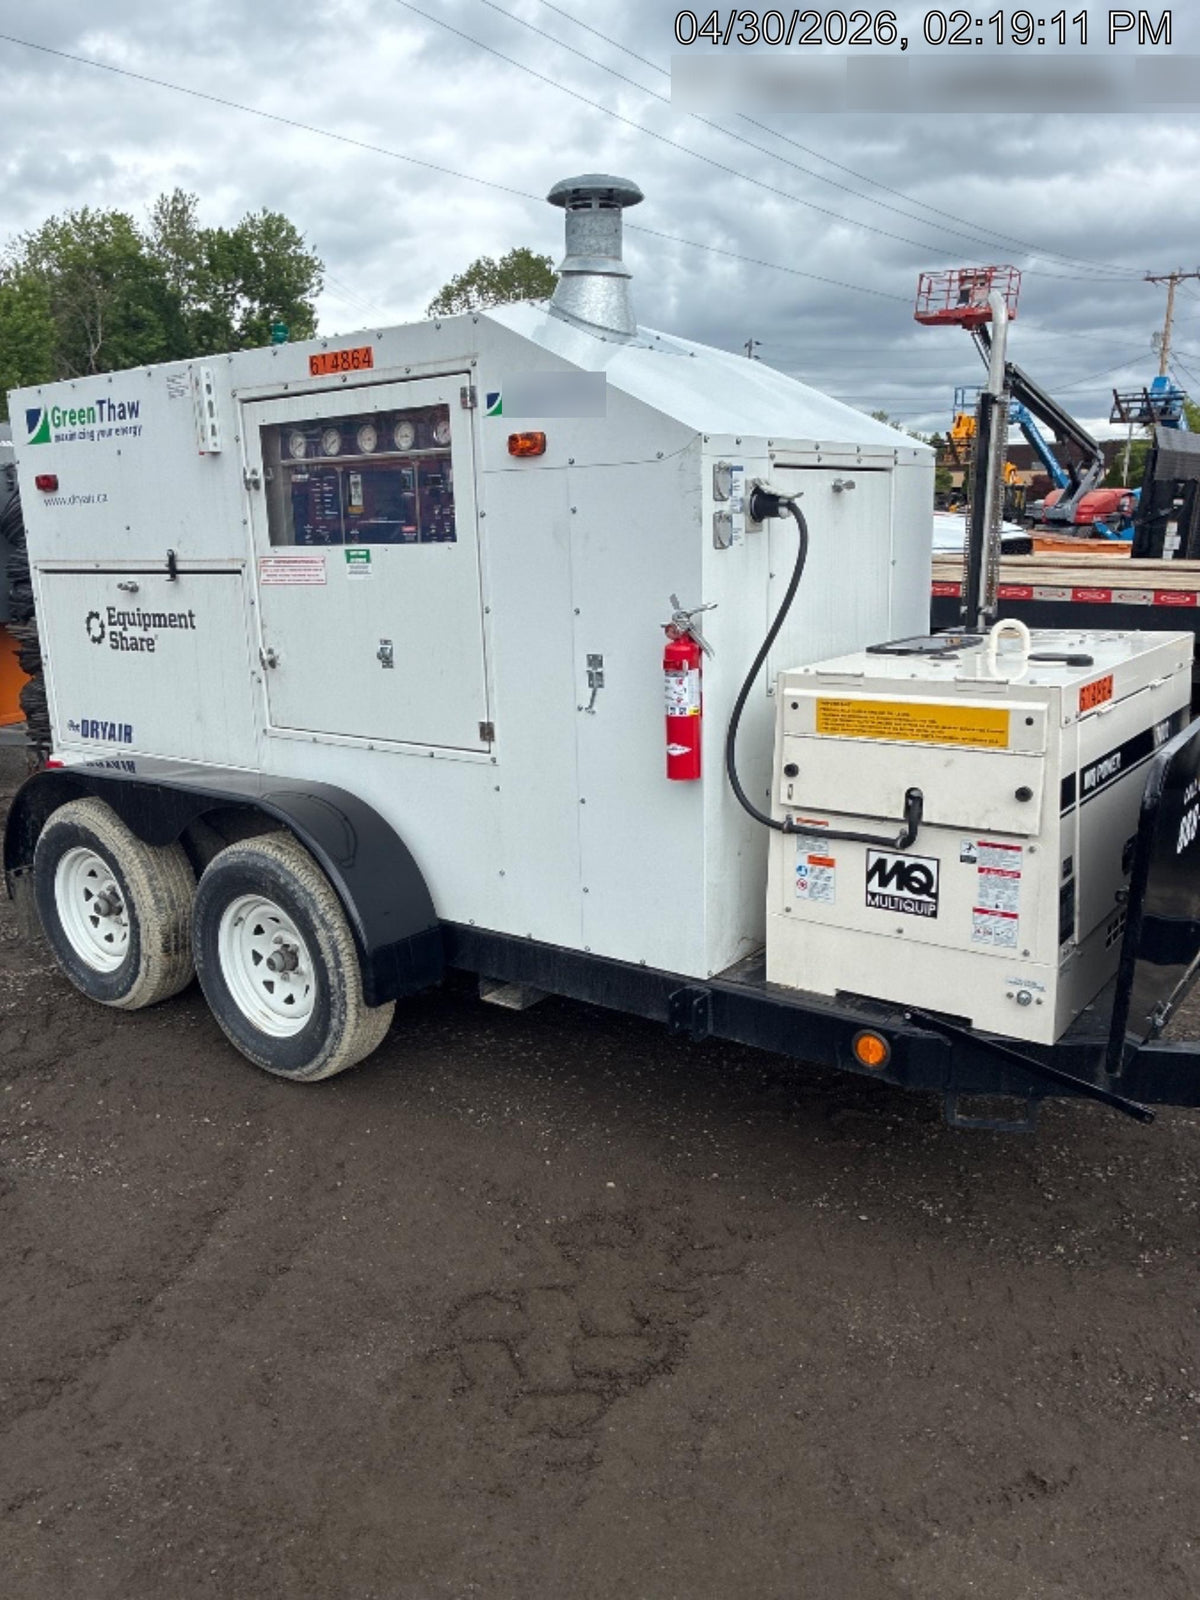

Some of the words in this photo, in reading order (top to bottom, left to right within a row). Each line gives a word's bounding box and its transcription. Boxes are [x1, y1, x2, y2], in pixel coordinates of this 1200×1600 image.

[310, 348, 372, 375] 614864
[106, 606, 196, 631] Equipment
[109, 631, 155, 652] Share
[81, 719, 132, 743] DRYAIR
[867, 857, 938, 900] MQ
[867, 892, 936, 916] MULTIQUIP
